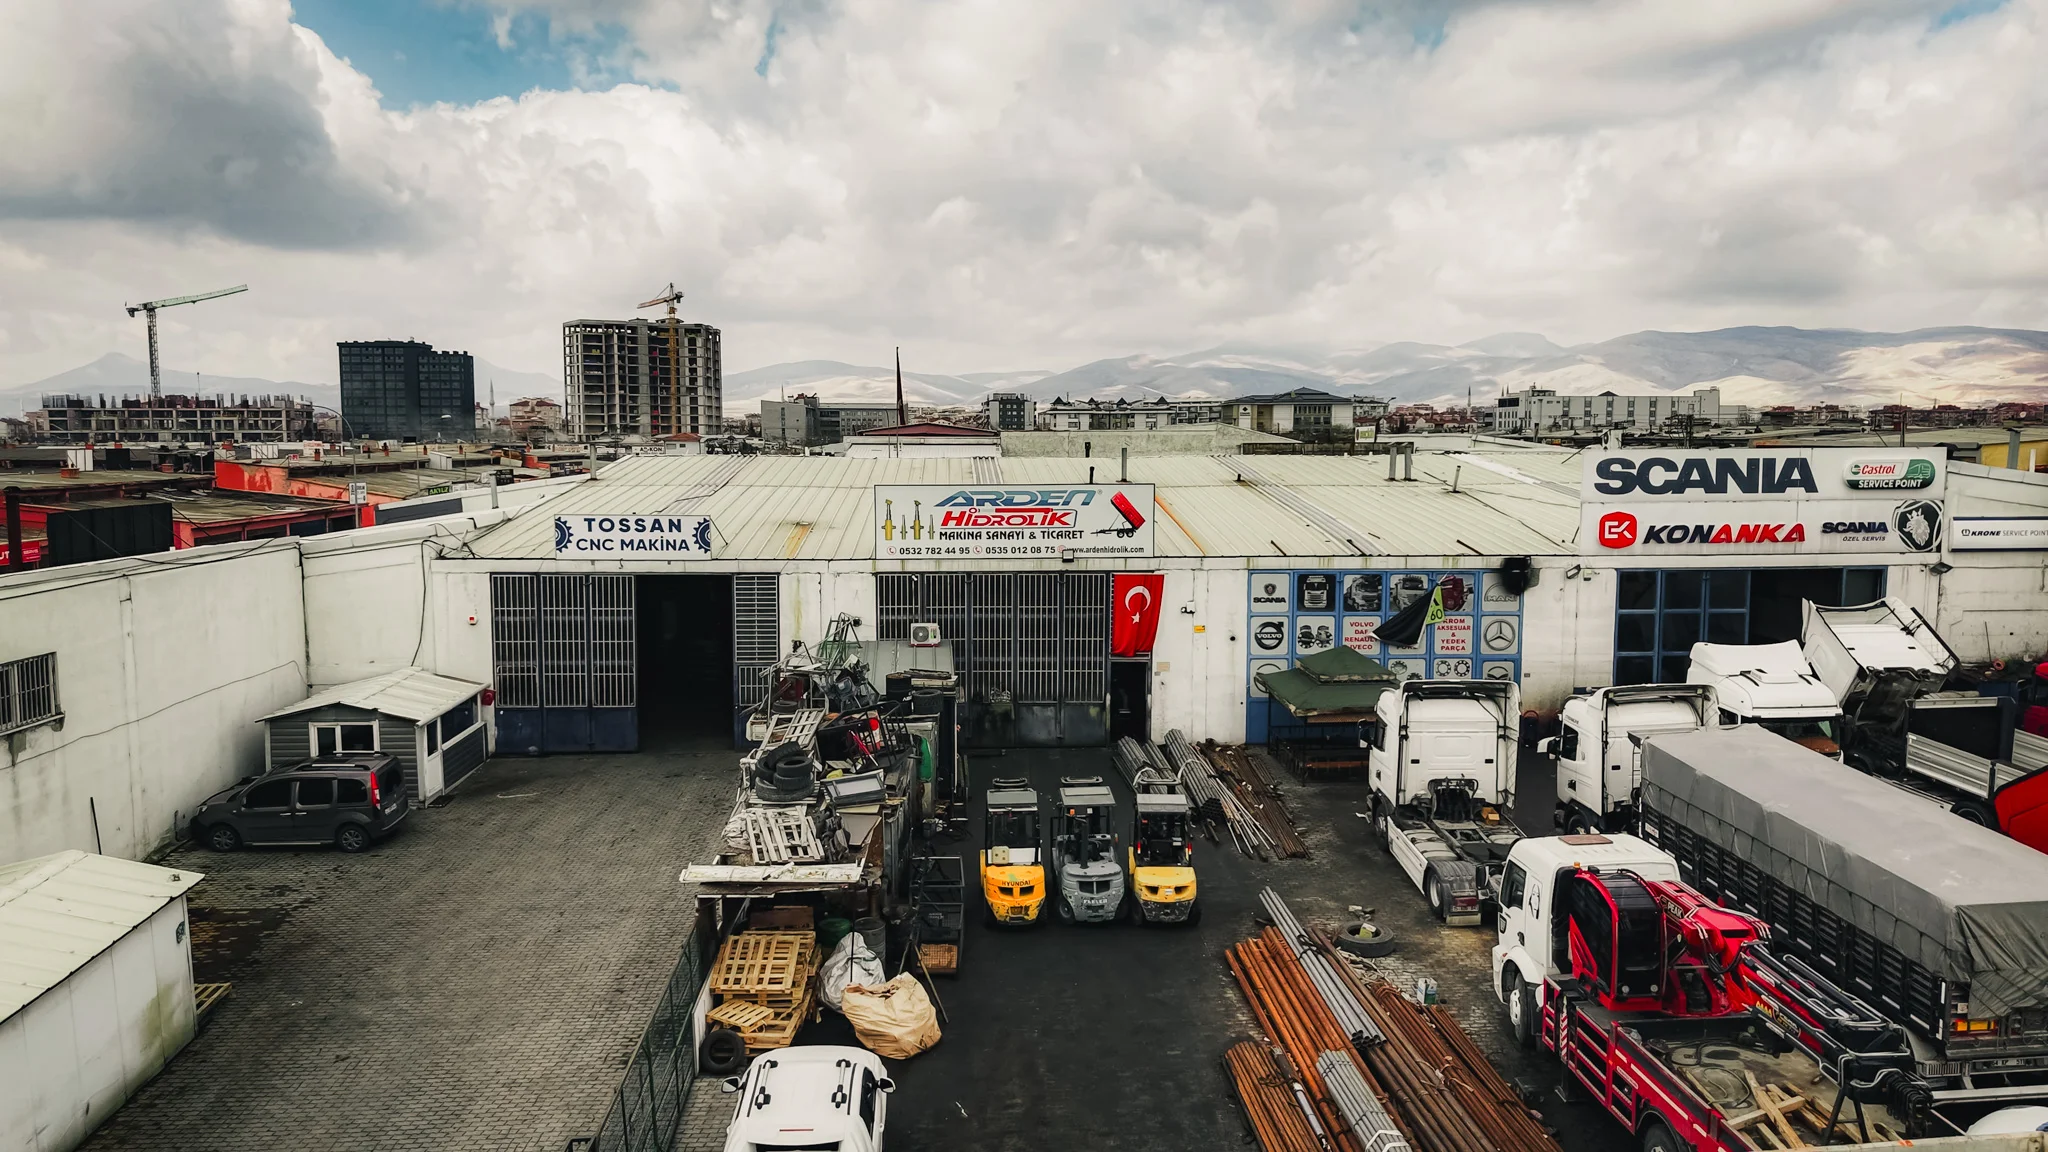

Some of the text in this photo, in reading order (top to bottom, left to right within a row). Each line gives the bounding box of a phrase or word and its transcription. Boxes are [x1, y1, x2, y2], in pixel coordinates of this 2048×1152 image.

[1594, 457, 1819, 495] SCANIA
[1861, 464, 1896, 475] Castrol
[1858, 479, 1923, 488] SERVICE POINT
[934, 489, 1097, 507] ARDEN
[583, 517, 682, 533] TOSSAN
[1821, 521, 1889, 533] SCANIA
[939, 528, 1084, 540] MAKİNA SANAYİ & TİCARET
[1642, 523, 1806, 544] KONANKA
[576, 535, 690, 551] CNC MAKİNA
[899, 547, 922, 555] 0532
[925, 547, 942, 555] 782
[985, 546, 1056, 554] 0535 012 08 75
[1430, 608, 1443, 621] 60
[1667, 901, 1682, 919] PEAK
